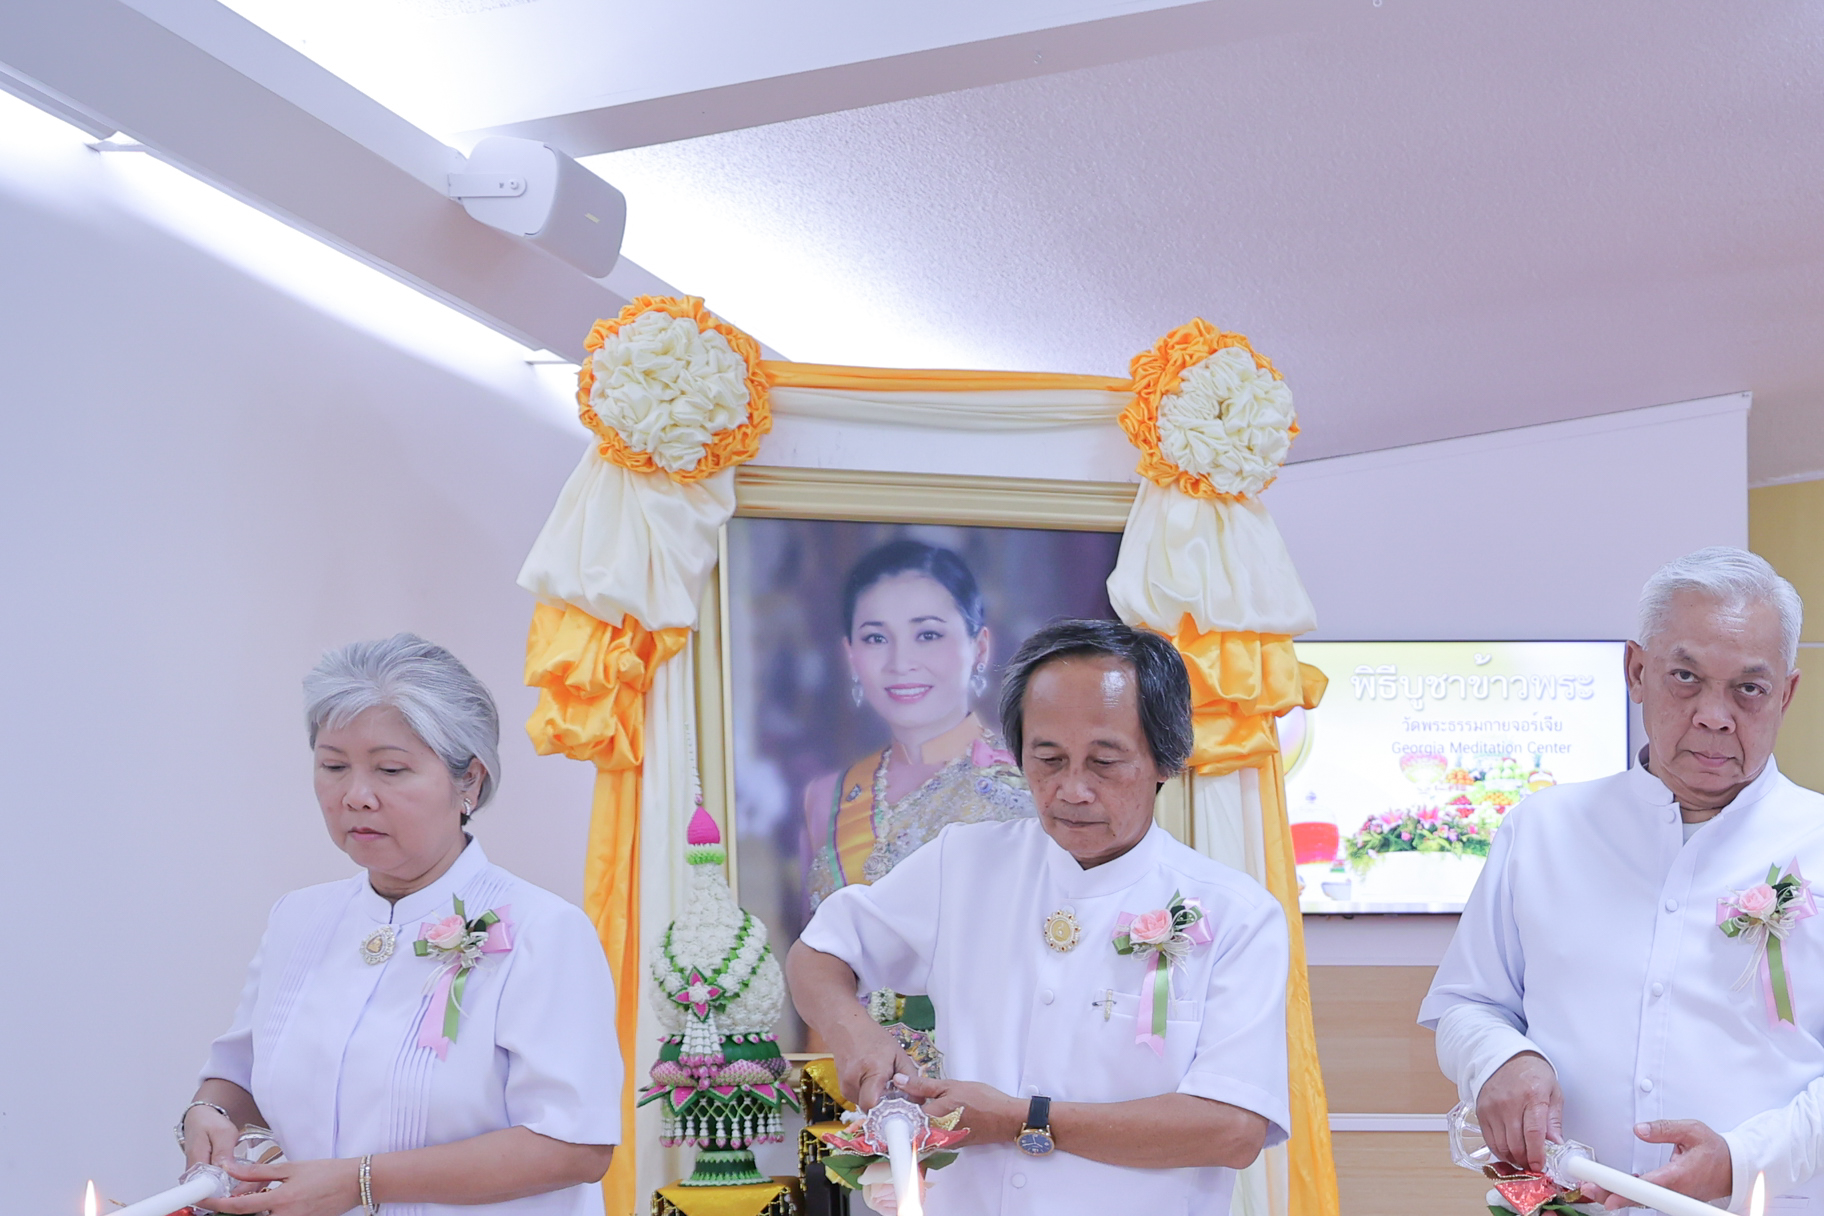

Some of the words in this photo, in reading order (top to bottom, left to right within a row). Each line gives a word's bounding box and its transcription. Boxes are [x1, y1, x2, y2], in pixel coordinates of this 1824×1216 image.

[1350, 653, 1594, 710] พิธีบูชาข้าวพระ
[1402, 712, 1563, 731] วัดพระธรรมกายจอร์เจีย
[1392, 742, 1445, 756] Georgia
[1450, 741, 1522, 754] Meditation
[1528, 742, 1572, 754] Center
